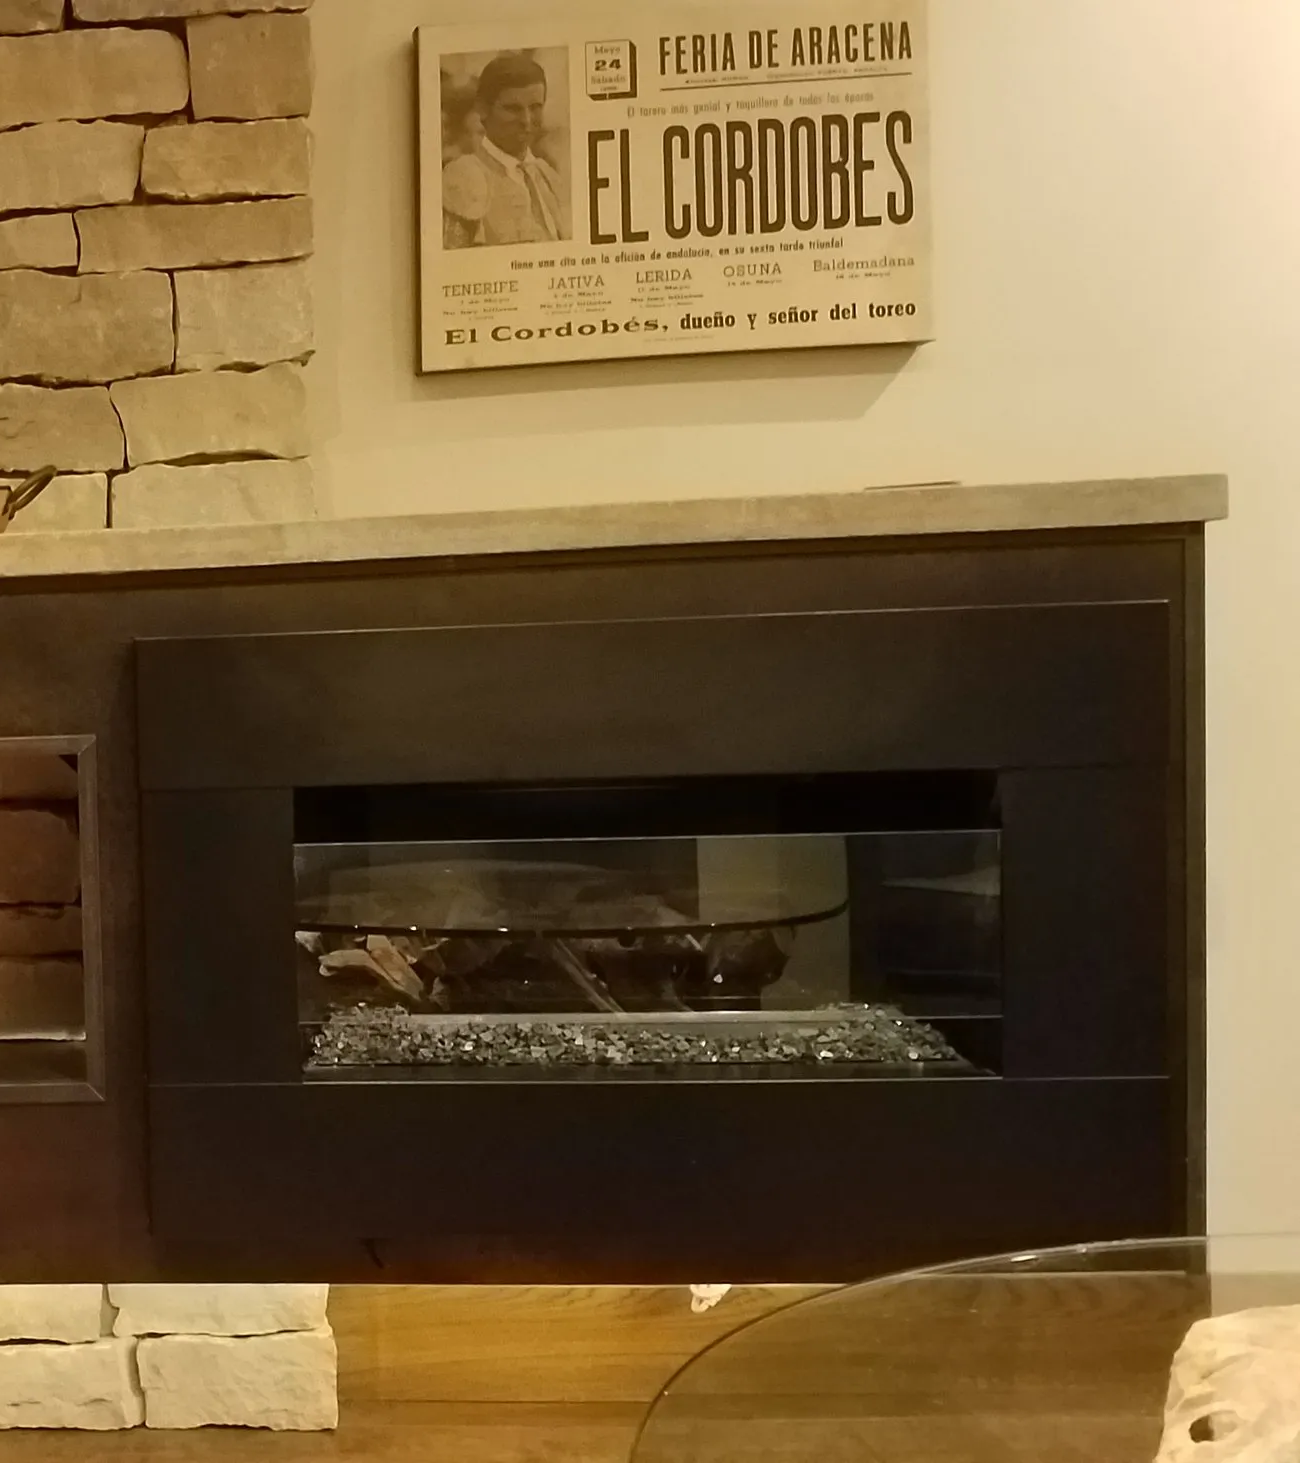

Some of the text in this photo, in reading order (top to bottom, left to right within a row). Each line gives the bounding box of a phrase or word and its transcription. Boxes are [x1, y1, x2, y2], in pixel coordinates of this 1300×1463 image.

[658, 20, 913, 76] FERIA DE ARACENA
[594, 58, 622, 72] 24
[693, 100, 721, 116] genial
[726, 102, 732, 114] y
[783, 95, 794, 107] de
[587, 110, 914, 245] EL CORDOBES
[511, 259, 534, 271] tiene
[538, 258, 555, 269] una
[560, 255, 577, 268] cita
[581, 256, 597, 266] con
[601, 252, 611, 264] la
[650, 248, 662, 260] de
[718, 247, 730, 256] en
[734, 245, 745, 255] su
[750, 243, 775, 255] sexta
[779, 239, 805, 252] tarde
[808, 236, 844, 250] triunfal
[635, 267, 692, 284] LERIDA
[723, 262, 782, 278] OSUNA
[442, 280, 519, 297] TENERIFE
[547, 274, 605, 290] JATIVA
[444, 302, 916, 346] El Cordobés, dueño y señor del toreo
